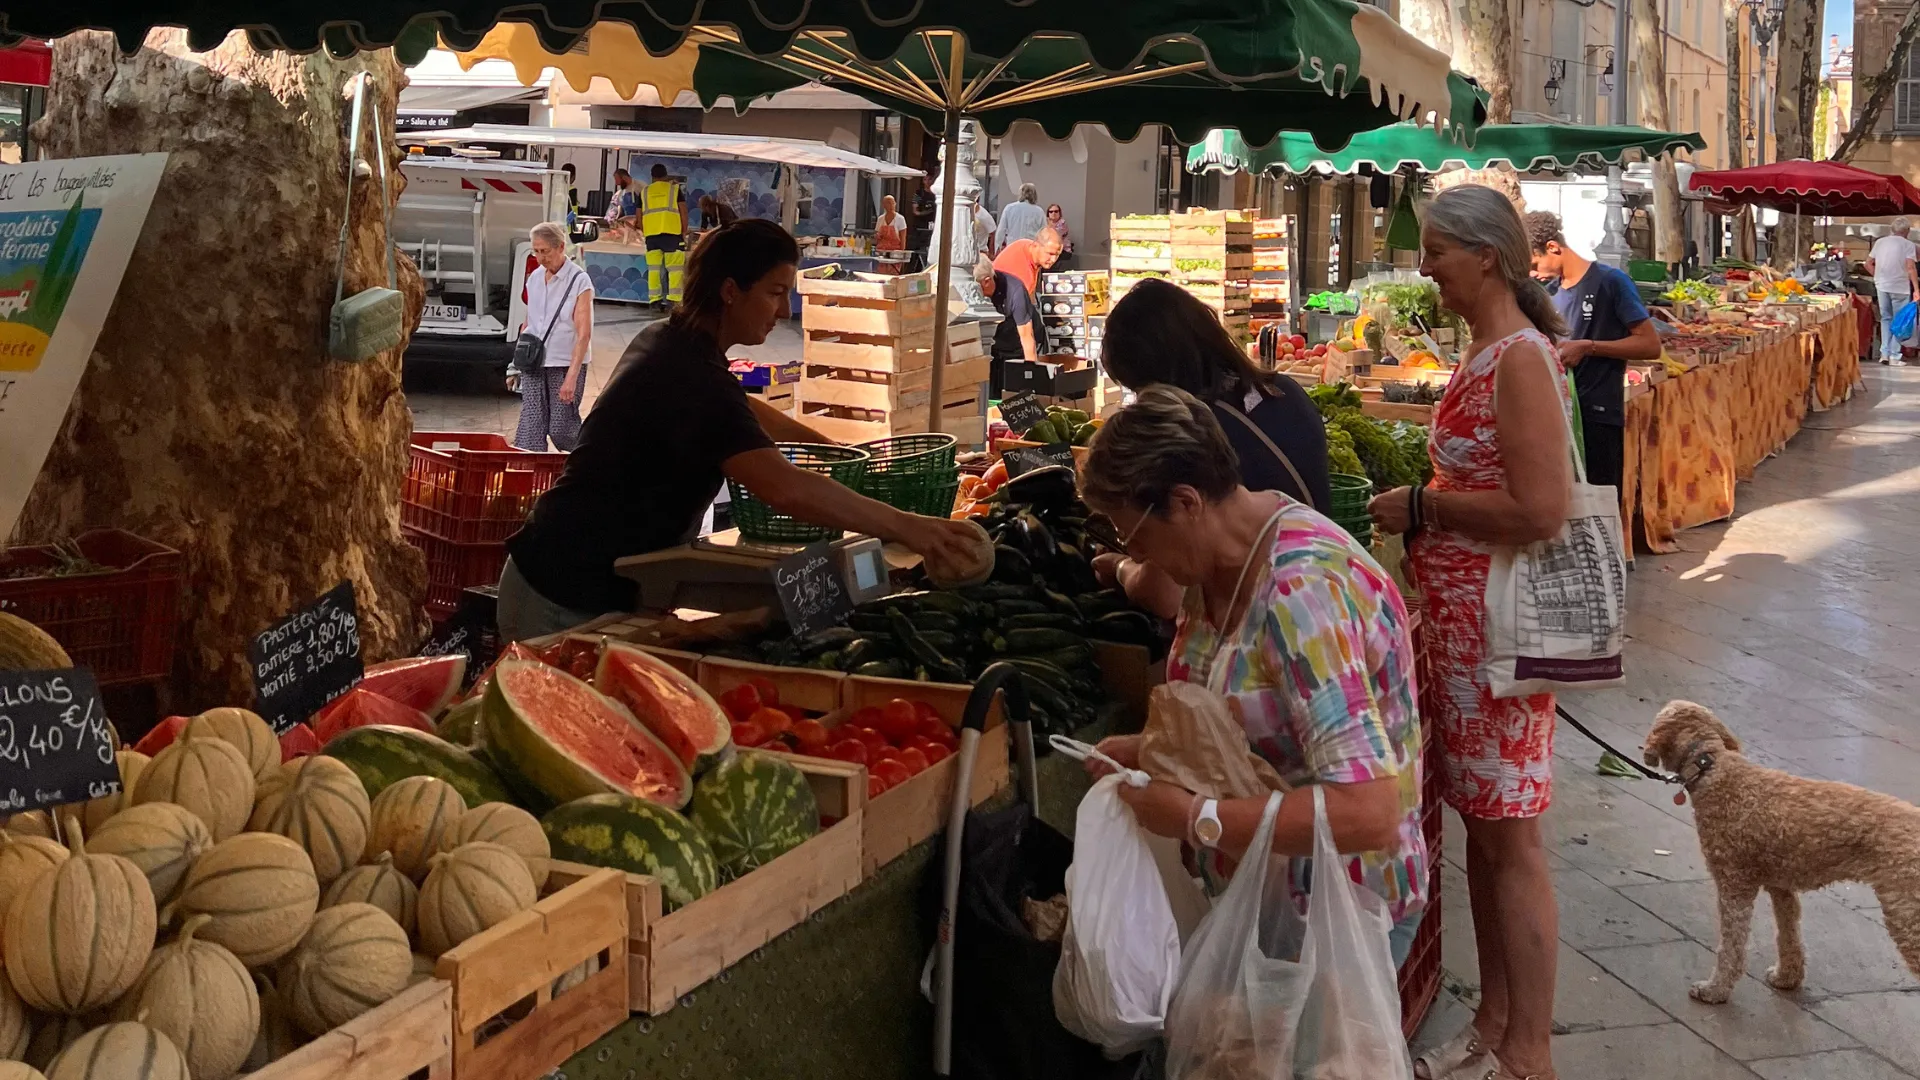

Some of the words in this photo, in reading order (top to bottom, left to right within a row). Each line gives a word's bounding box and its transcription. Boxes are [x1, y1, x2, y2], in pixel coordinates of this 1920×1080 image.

[411, 117, 427, 126] Salon
[428, 118, 437, 126] de
[438, 118, 449, 126] thé
[27, 169, 47, 197] Les
[0, 238, 50, 260] ferme
